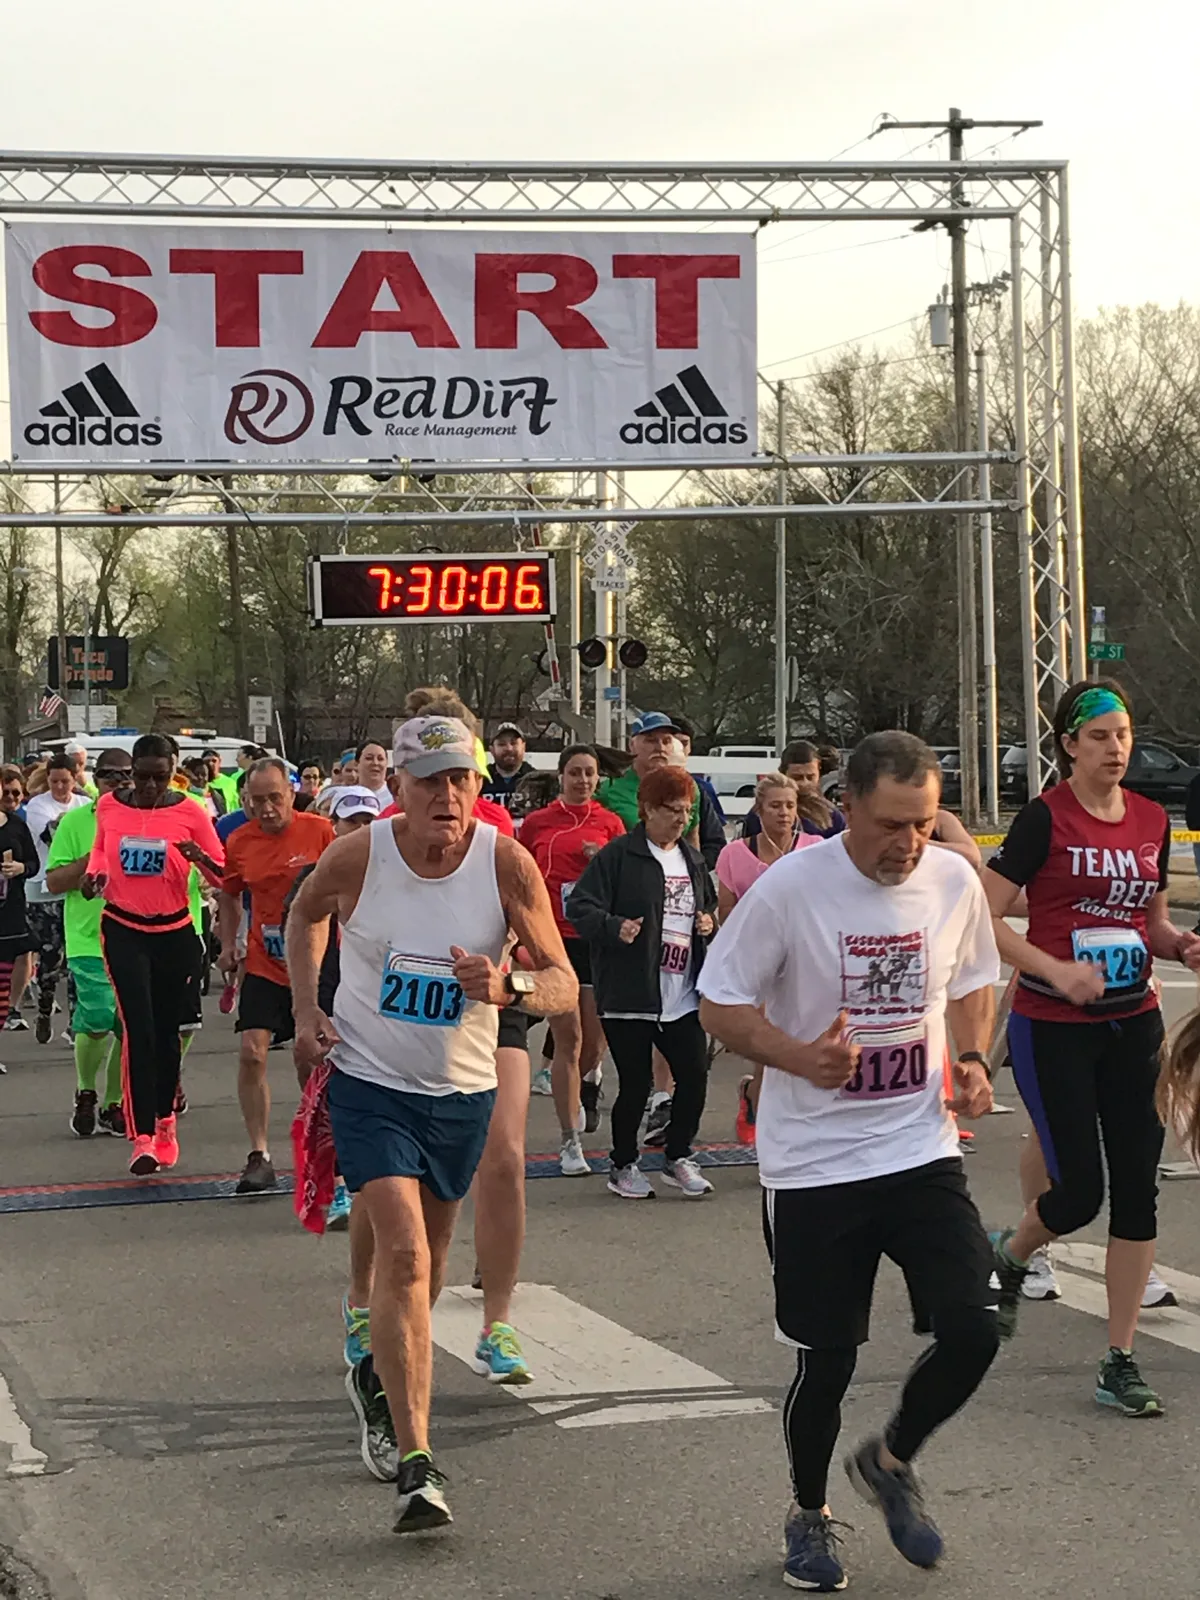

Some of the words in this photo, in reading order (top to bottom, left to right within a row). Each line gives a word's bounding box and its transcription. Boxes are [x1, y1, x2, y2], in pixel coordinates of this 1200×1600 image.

[28, 245, 740, 349] START
[24, 416, 163, 446] adidas
[385, 423, 420, 436] Race
[424, 424, 517, 438] Management
[619, 416, 748, 444] adidas
[596, 580, 625, 589] TRACKS
[606, 567, 614, 577] 2
[367, 565, 543, 612] 7:30:06
[1108, 645, 1122, 659] ST
[120, 849, 165, 873] 2125
[1067, 846, 1140, 878] TEAM
[381, 974, 463, 1021] 2103
